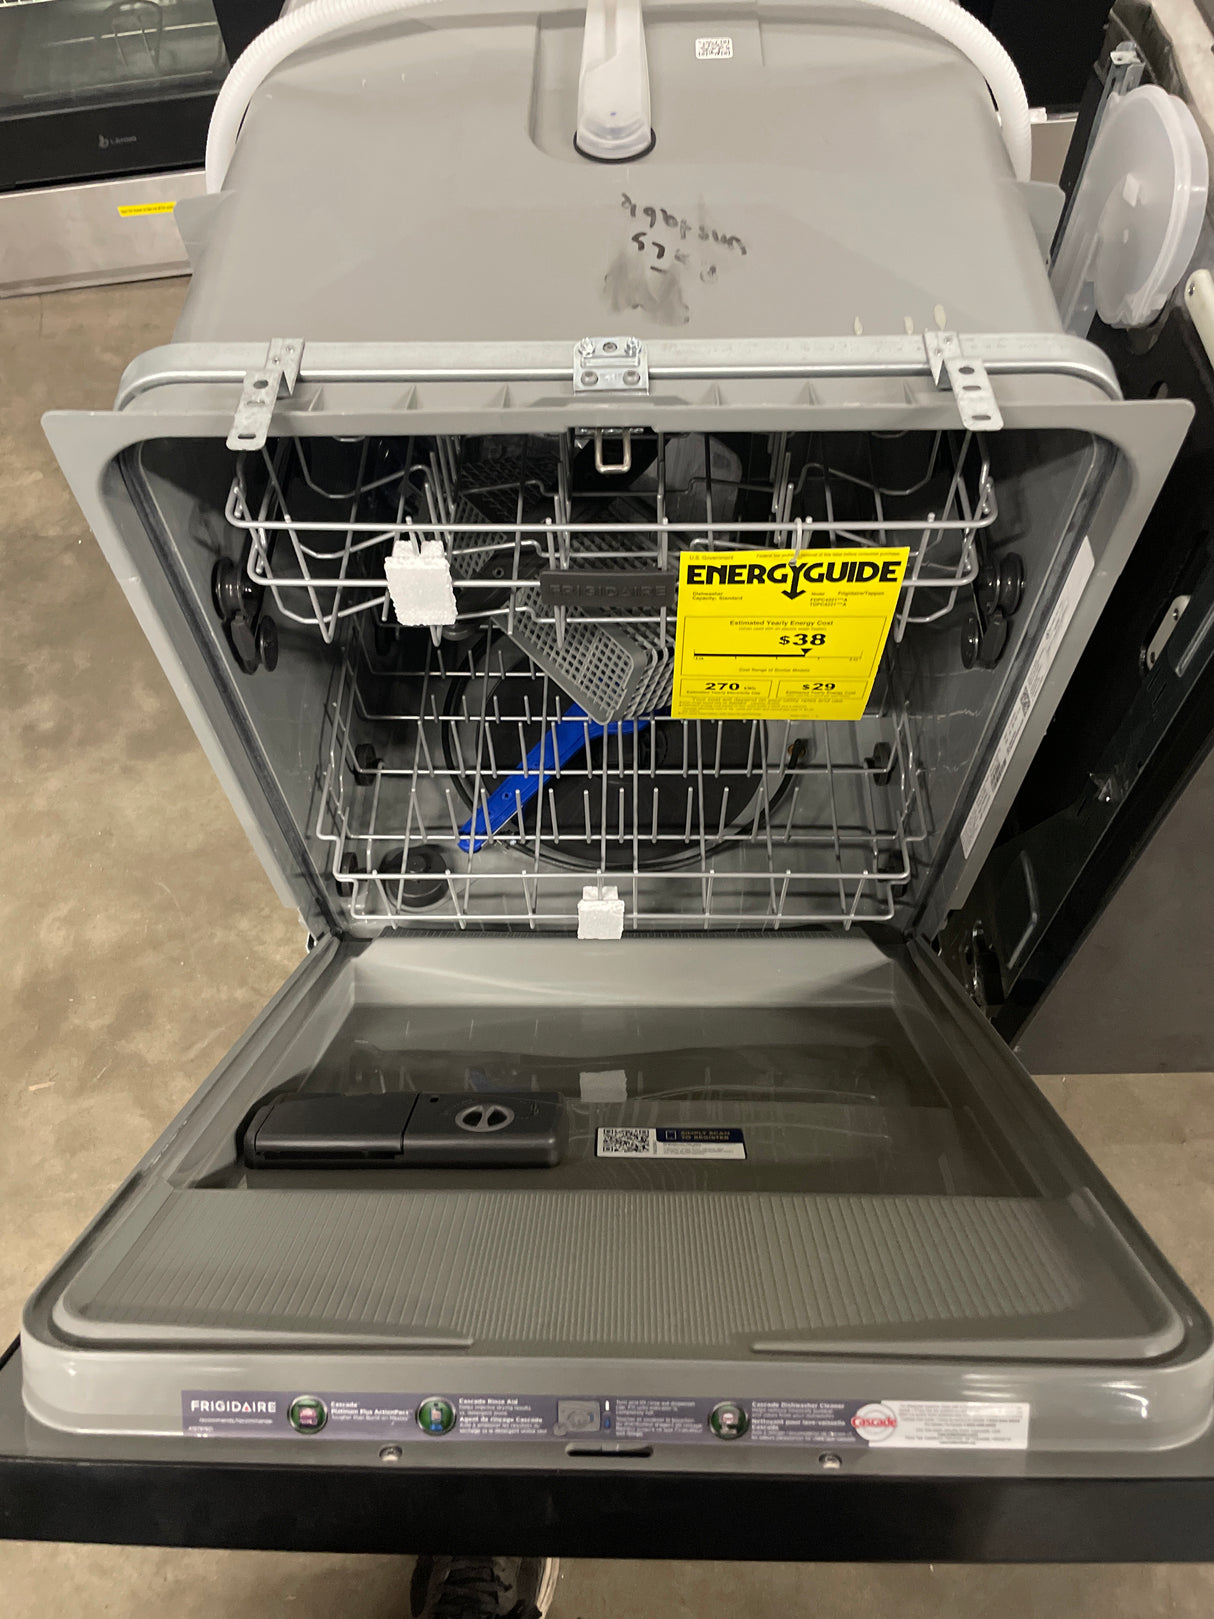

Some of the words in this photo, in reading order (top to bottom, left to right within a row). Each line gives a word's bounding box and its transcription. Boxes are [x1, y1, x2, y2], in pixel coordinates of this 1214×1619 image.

[687, 561, 902, 594] ENERGYGUIDE
[550, 584, 667, 598] FRIGIDAIRE
[778, 633, 826, 646] $38
[705, 682, 740, 690] 270
[802, 682, 836, 690] $29
[191, 1400, 276, 1413] FRIGIDAIRE
[851, 1416, 898, 1429] Cascade
